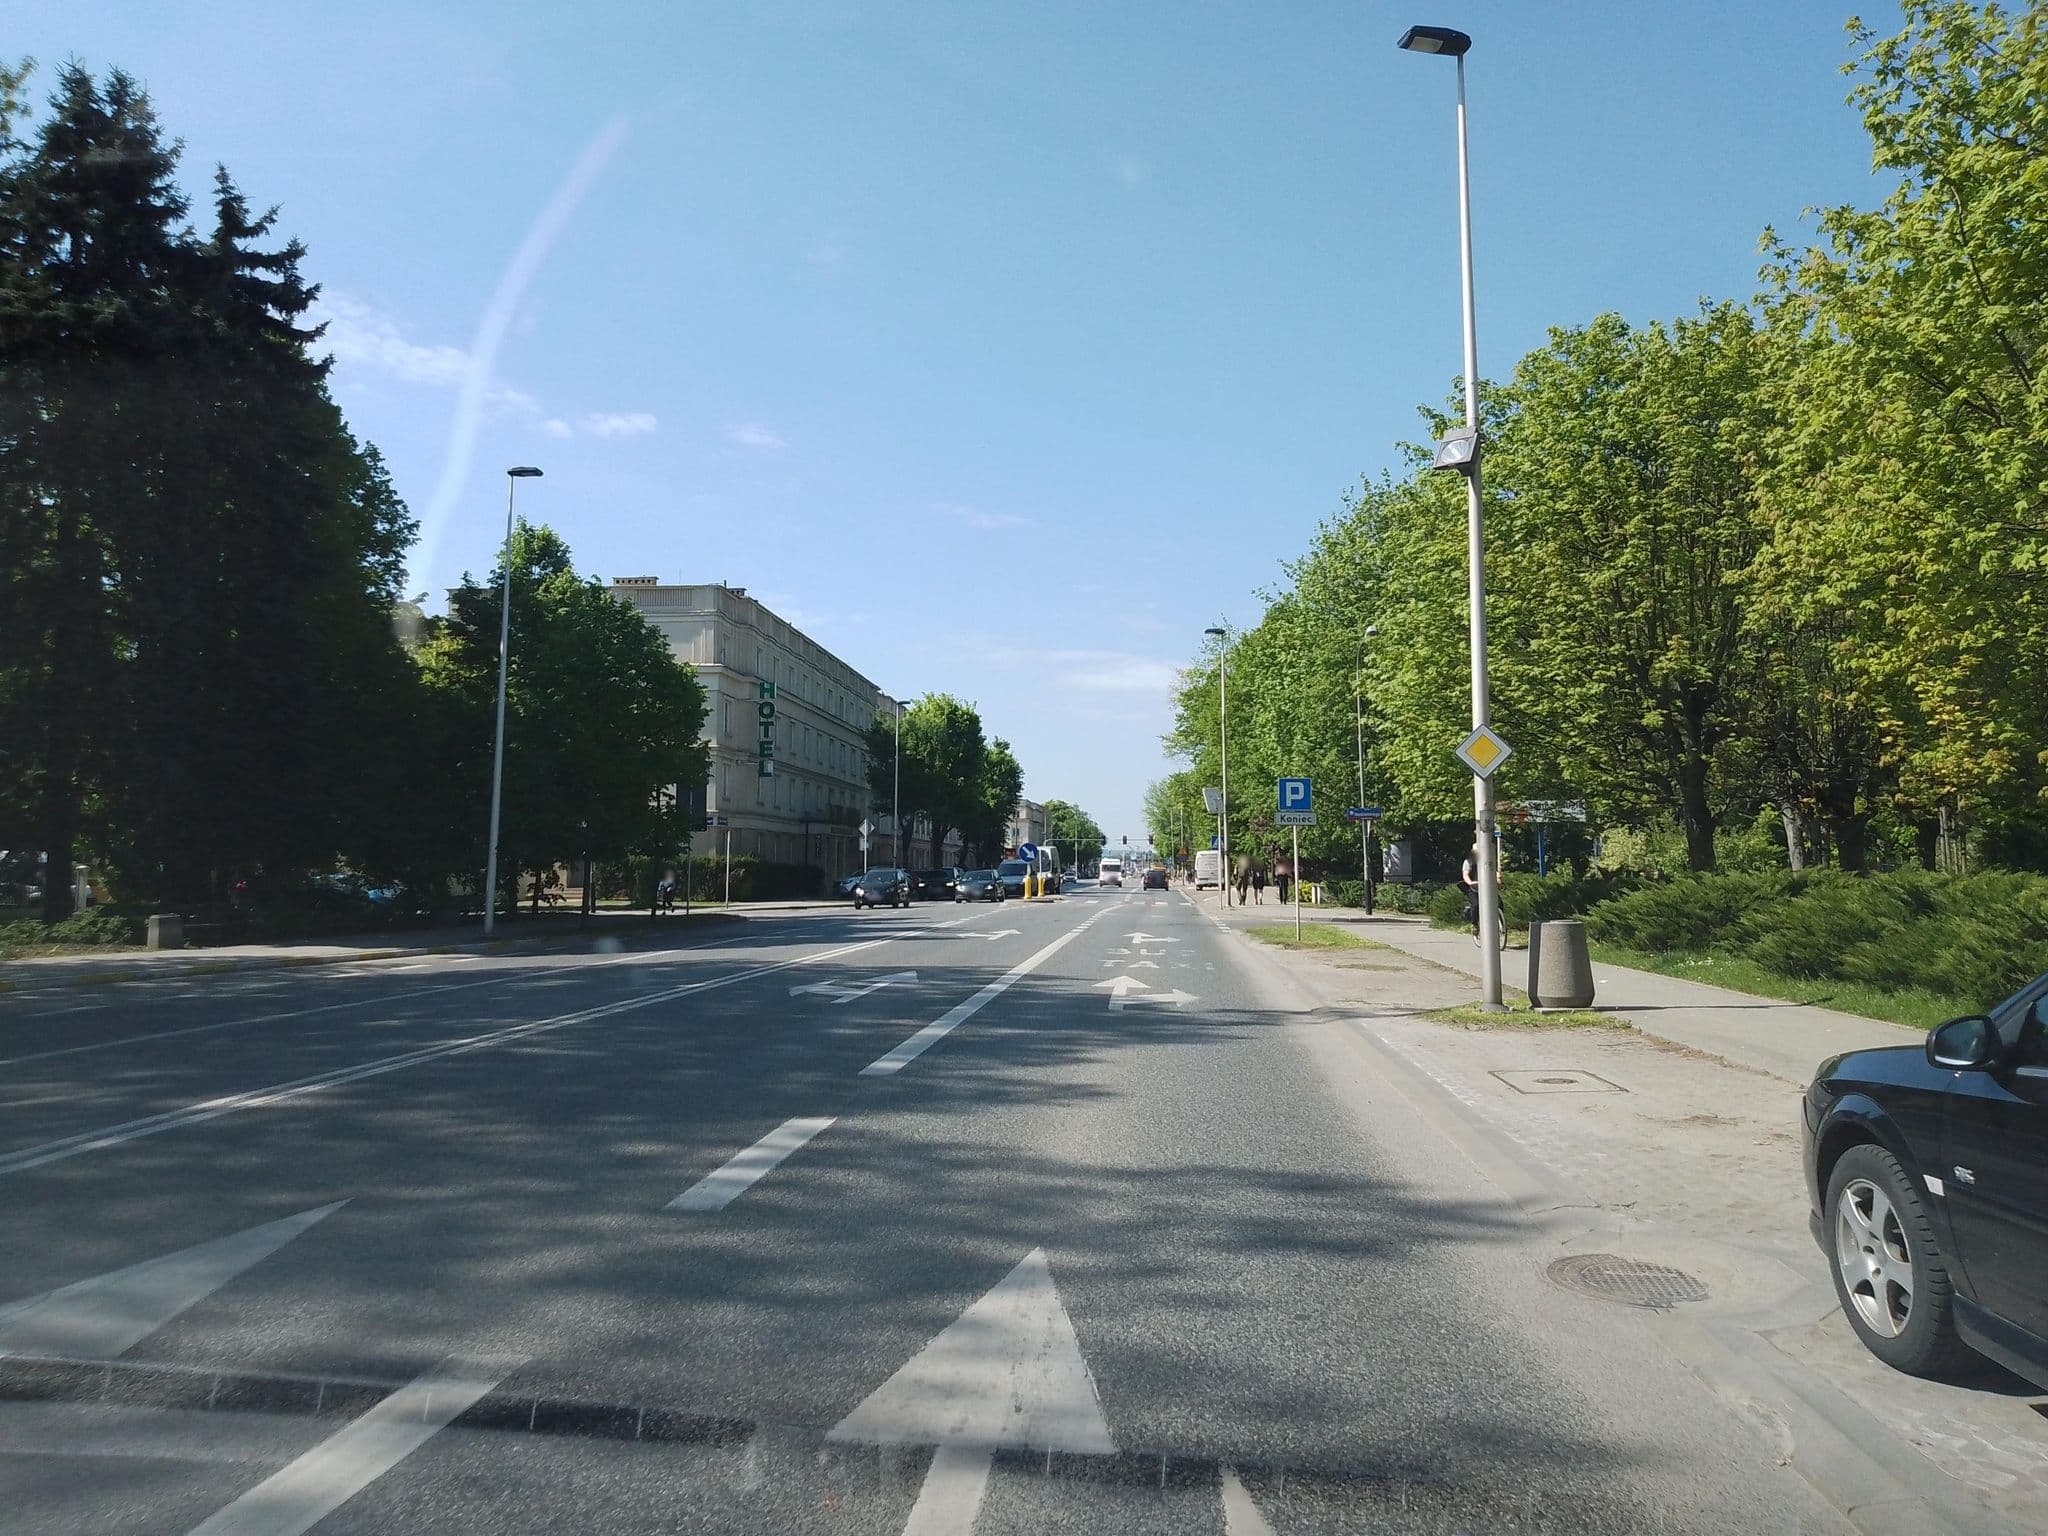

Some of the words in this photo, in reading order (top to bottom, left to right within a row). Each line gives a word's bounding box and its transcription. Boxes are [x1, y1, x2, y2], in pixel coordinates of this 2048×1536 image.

[759, 682, 776, 777] HOTEL
[1285, 781, 1305, 807] P
[1280, 815, 1312, 823] Koniec
